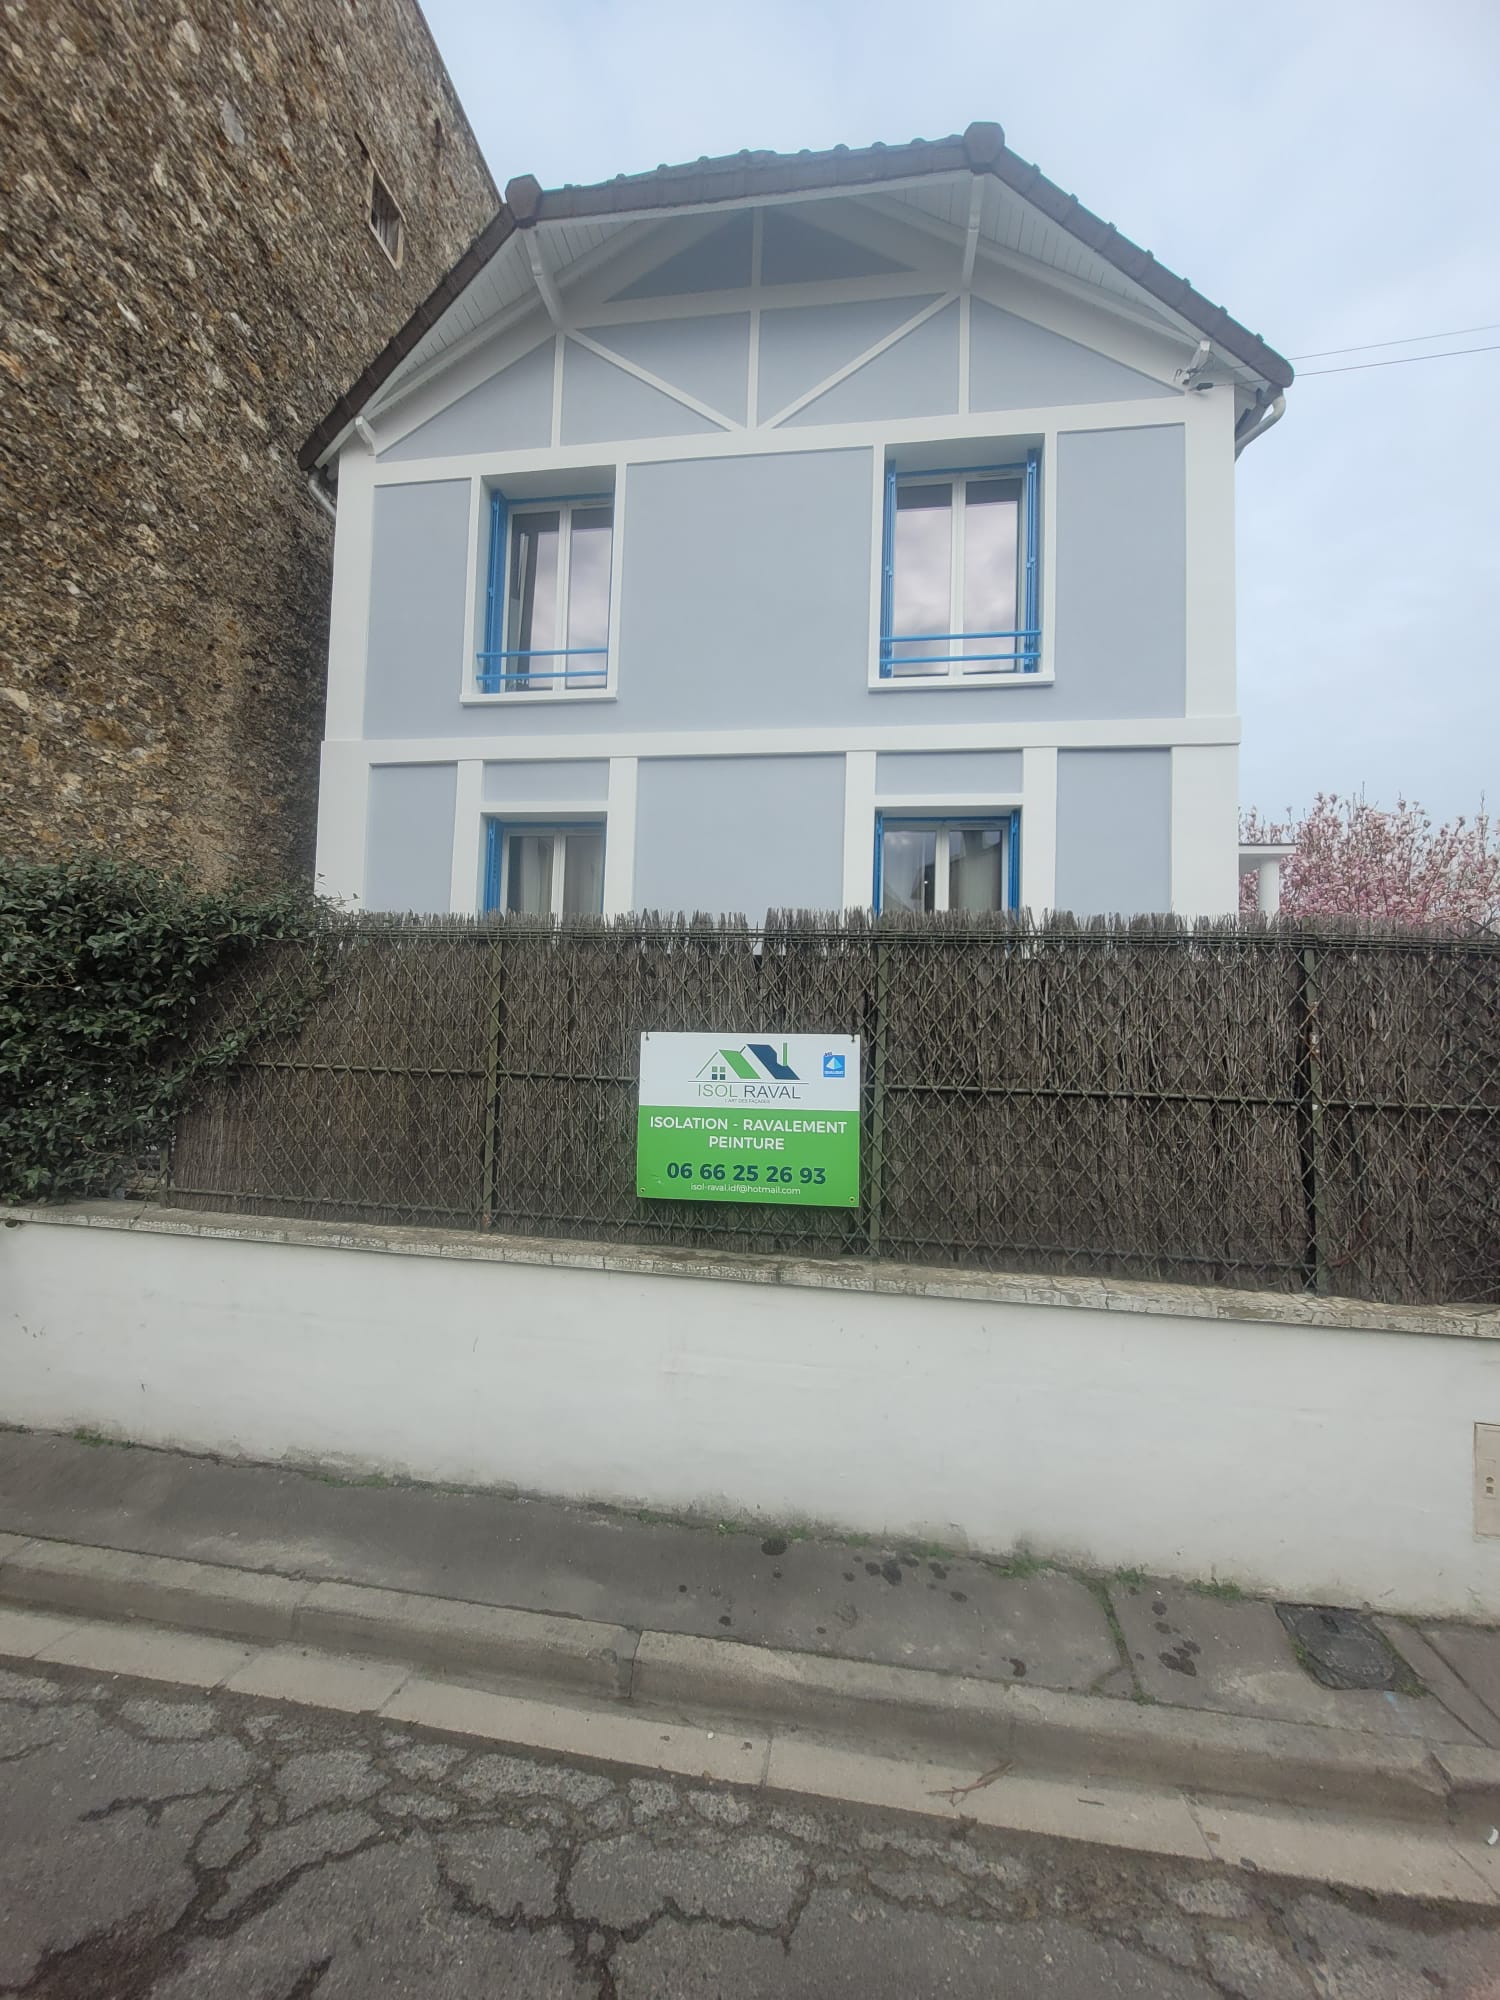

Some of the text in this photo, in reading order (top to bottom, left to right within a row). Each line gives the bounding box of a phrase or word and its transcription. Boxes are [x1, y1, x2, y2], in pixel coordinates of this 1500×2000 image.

[698, 1084, 801, 1100] ISOL RAVAL
[650, 1116, 728, 1130] ISOLATION
[743, 1119, 847, 1134] RAVALEMENT
[708, 1135, 785, 1150] PEINTURE
[666, 1162, 826, 1185] 06 66 25 26 93
[690, 1183, 801, 1195] isol-raval.idf@hotmail.com
